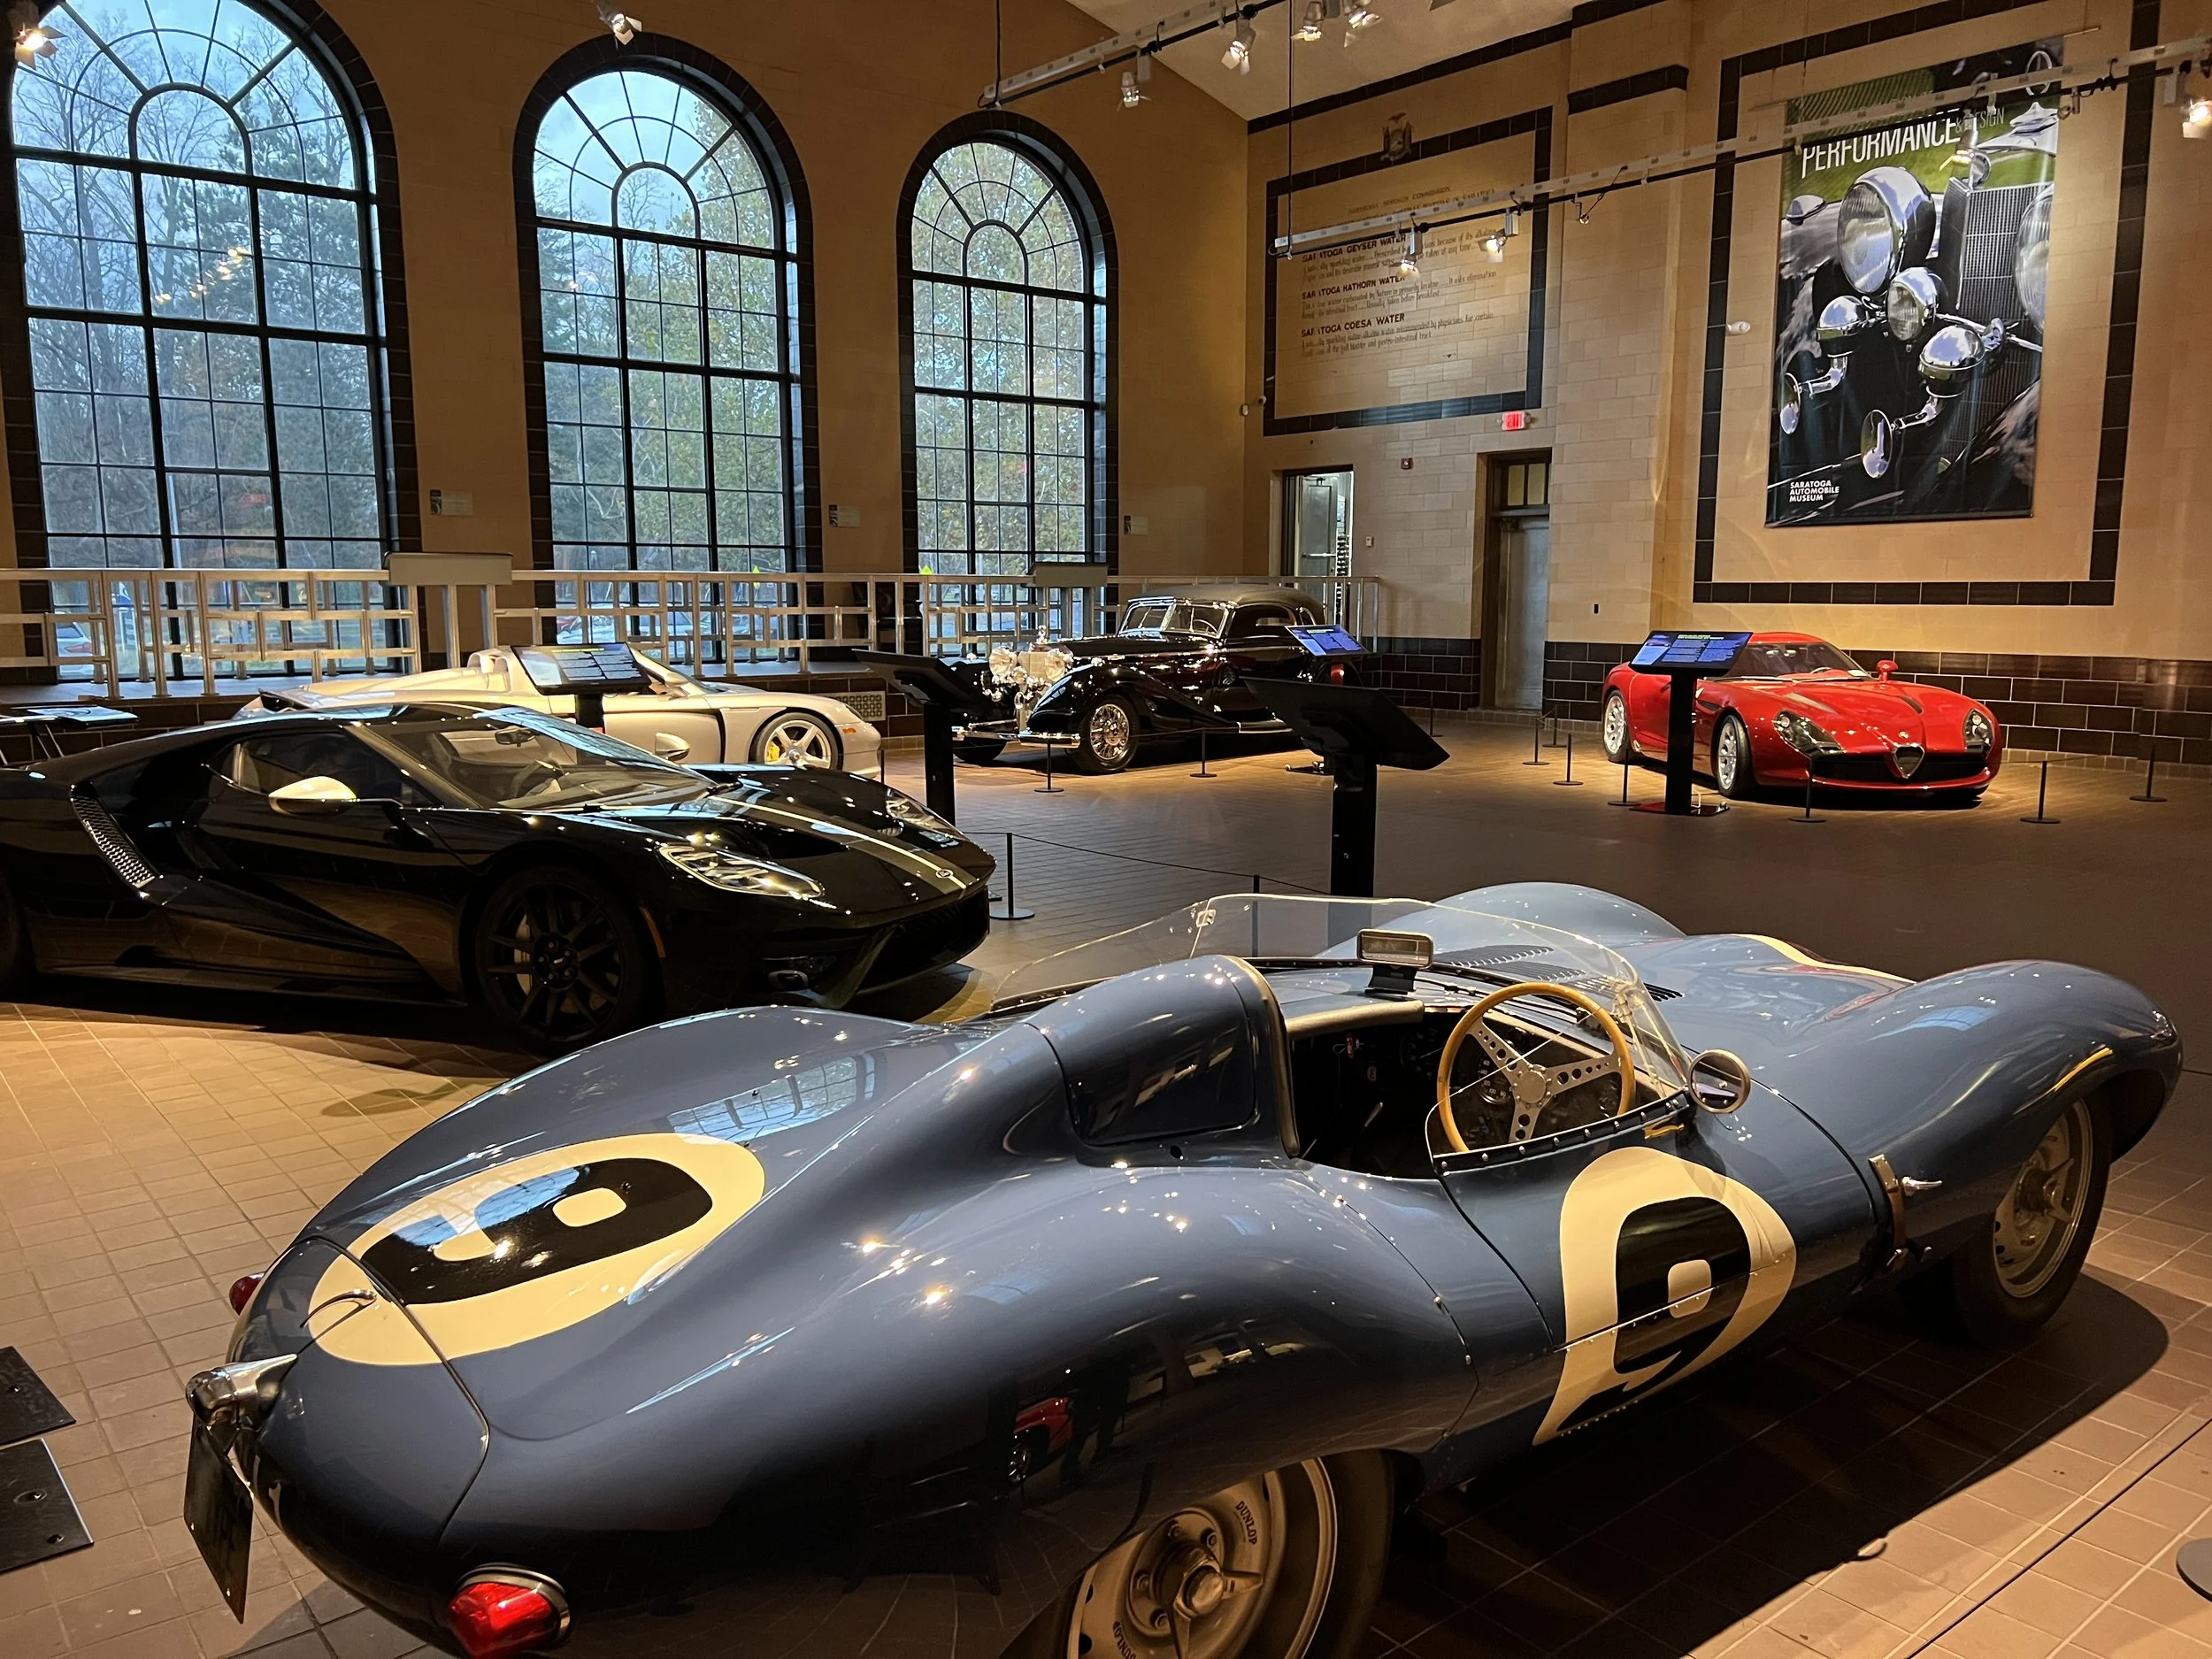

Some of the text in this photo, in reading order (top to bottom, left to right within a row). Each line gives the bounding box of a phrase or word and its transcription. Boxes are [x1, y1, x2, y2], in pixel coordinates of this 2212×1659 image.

[1801, 107, 1962, 179] PERFORMANCE
[1347, 240, 1377, 253] GEYSER
[1380, 234, 1406, 246] WATER
[1343, 280, 1376, 292] HATHORN
[1344, 319, 1371, 331] COESA
[1376, 312, 1405, 325] WATER
[1789, 486, 1839, 495] AUTOMOBILE
[1790, 480, 1832, 489] SARATOGA
[1789, 494, 1824, 503] MUSEUM
[1235, 1501, 1257, 1545] DUNLOP
